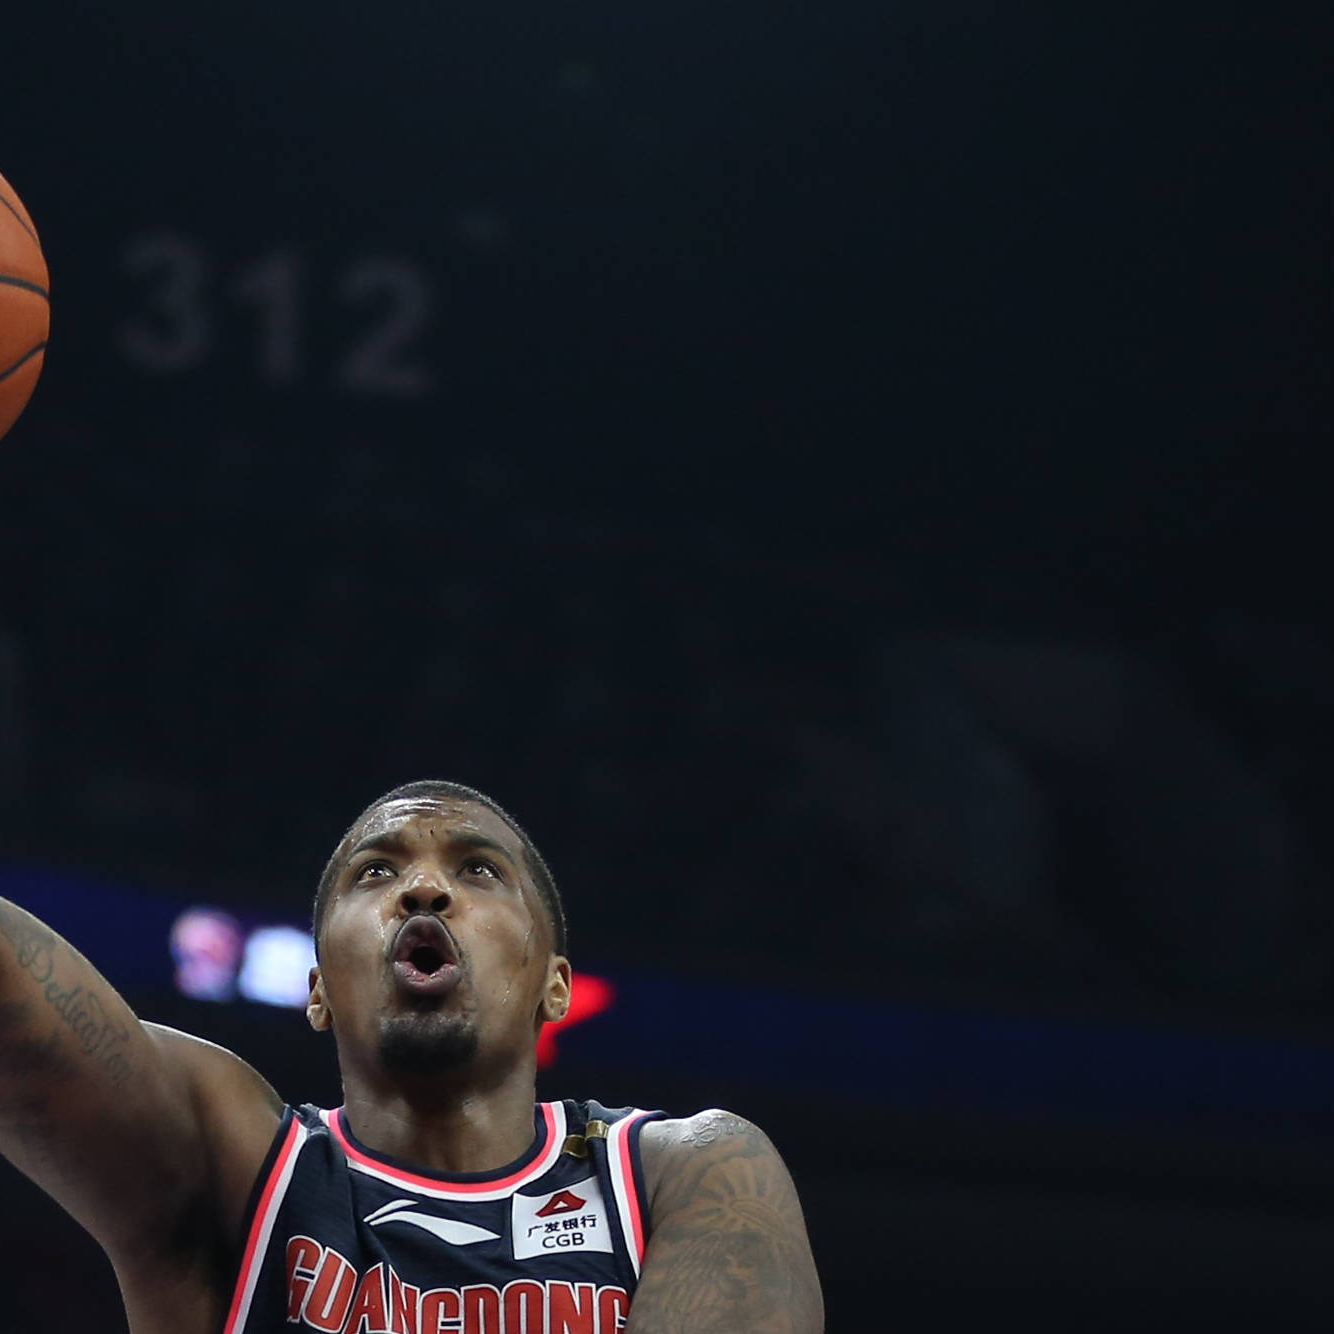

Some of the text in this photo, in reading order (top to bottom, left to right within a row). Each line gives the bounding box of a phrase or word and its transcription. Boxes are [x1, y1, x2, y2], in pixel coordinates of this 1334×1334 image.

[119, 232, 437, 394] 312
[527, 1214, 597, 1238] 广发银行
[542, 1232, 585, 1249] CGB
